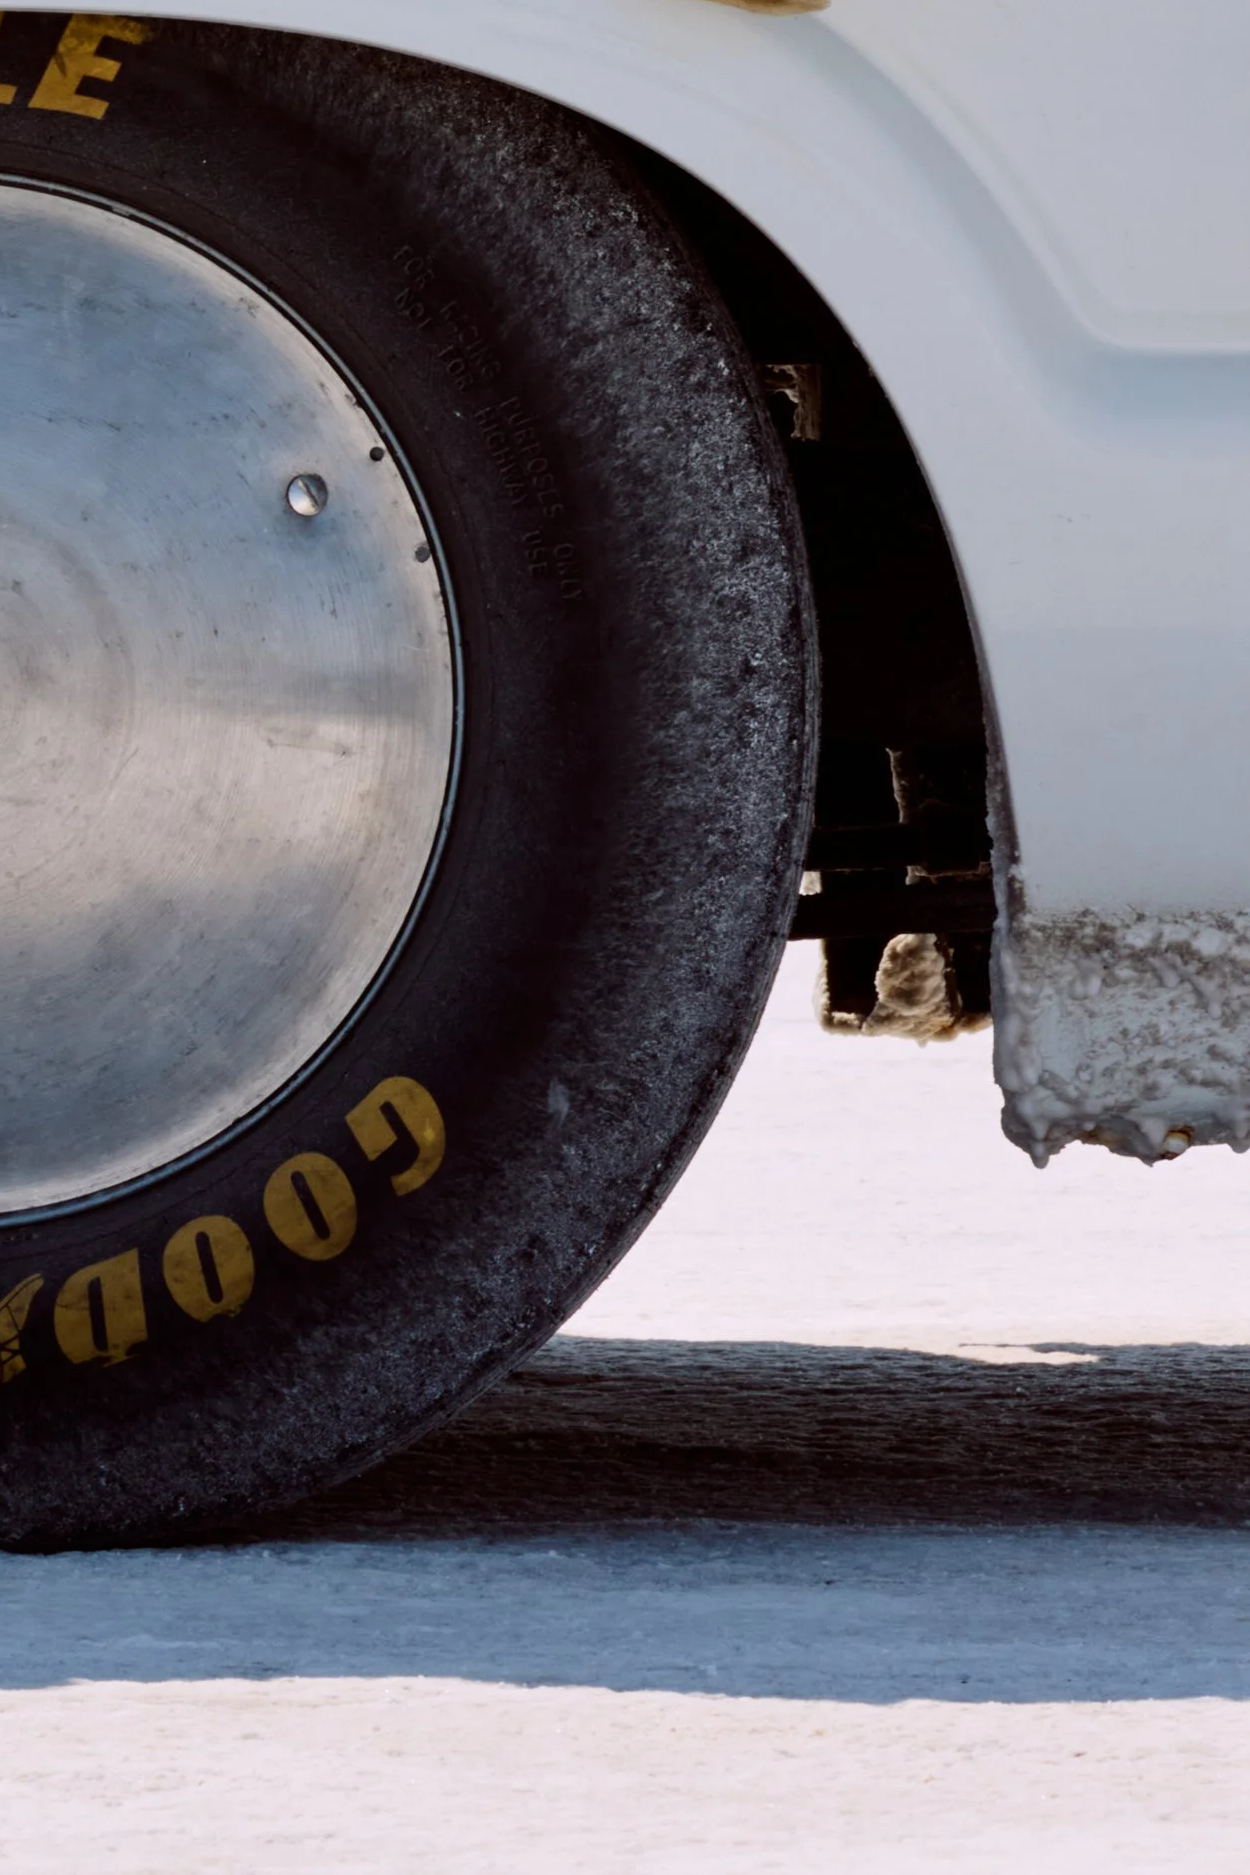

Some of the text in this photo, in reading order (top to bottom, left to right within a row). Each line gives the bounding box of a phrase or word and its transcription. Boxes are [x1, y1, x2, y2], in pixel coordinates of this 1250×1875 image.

[392, 243, 585, 604] FOR RACING PURPOSES ONLY
[435, 343, 477, 394] FOR
[472, 405, 530, 508] HIGHWAY
[521, 527, 551, 577] USE
[54, 1077, 446, 1363] GOOD
